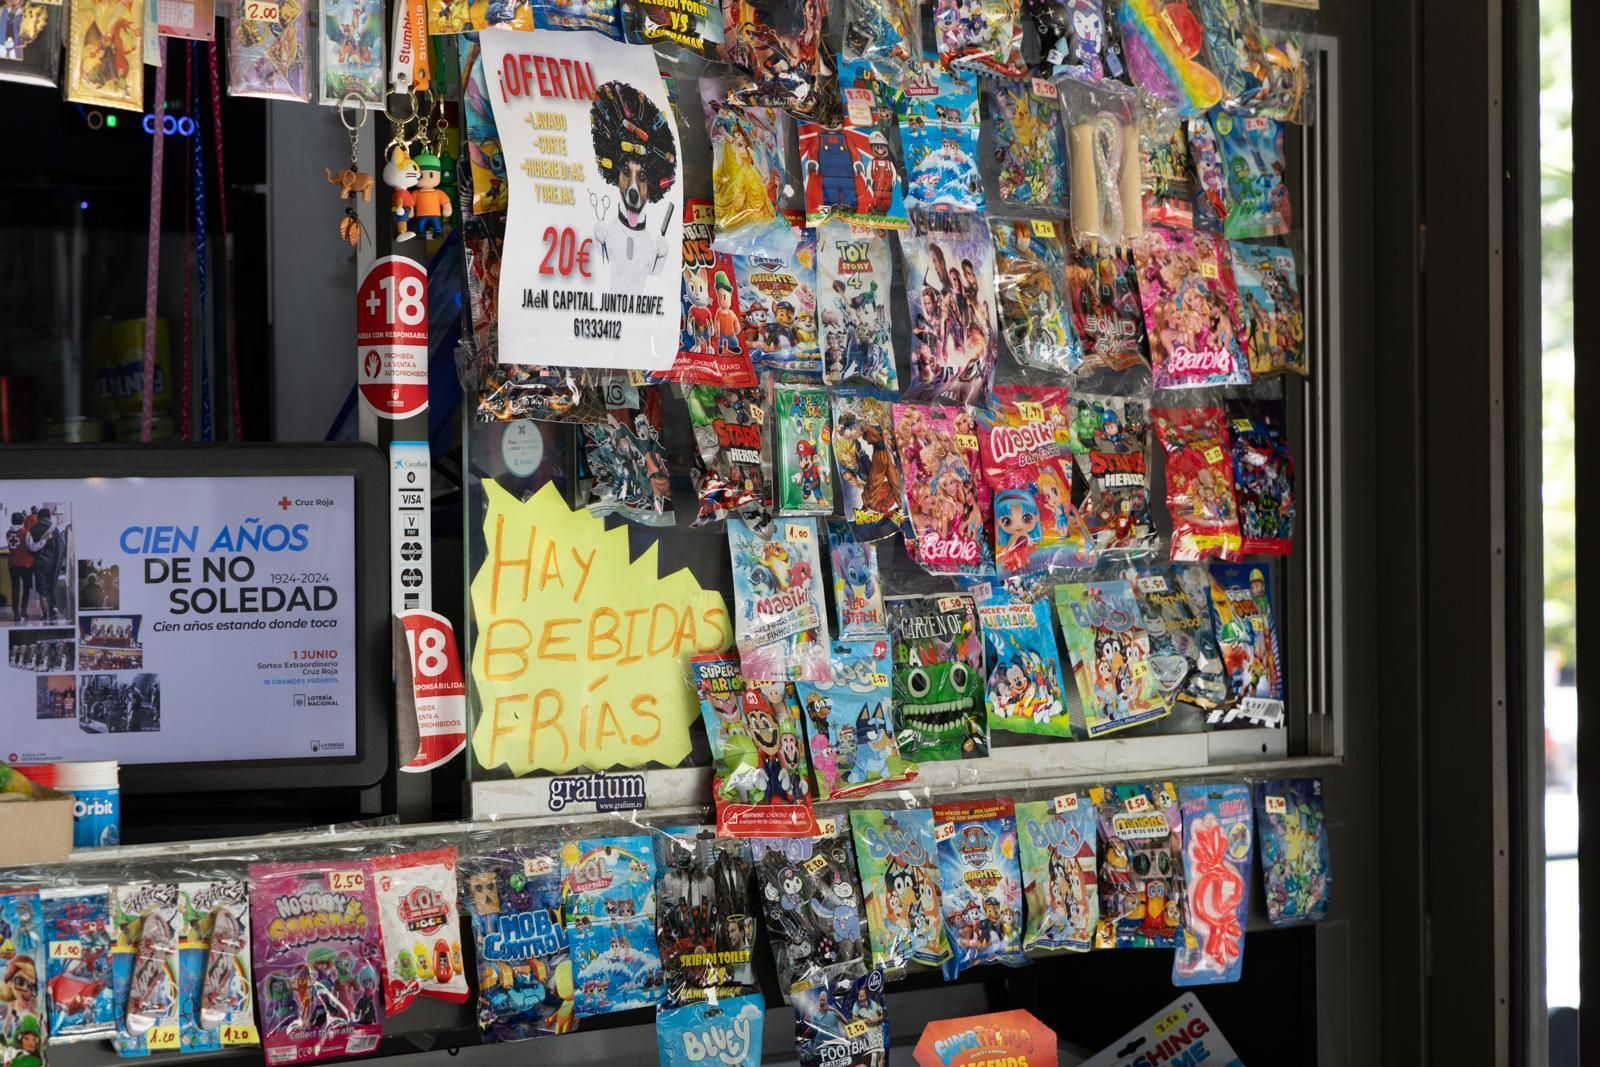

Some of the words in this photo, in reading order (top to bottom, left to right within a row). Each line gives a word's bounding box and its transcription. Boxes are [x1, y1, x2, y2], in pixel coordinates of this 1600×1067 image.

[249, 4, 278, 19] 2.00
[670, 11, 688, 32] VS
[399, 11, 412, 64] Stumbl
[538, 226, 593, 278] 20€
[836, 241, 869, 262] TOY
[842, 262, 869, 270] STORY
[847, 272, 862, 289] 4
[366, 276, 426, 326] +18
[553, 290, 598, 313] CAPITAL.
[599, 293, 627, 314] JUNTO
[628, 294, 635, 313] A
[636, 295, 665, 316] RENFE.
[573, 317, 622, 340] 613334112
[1172, 346, 1235, 371] Barbie
[295, 499, 314, 507] Cruz
[315, 498, 334, 507] Roja
[402, 494, 422, 504] VISA
[119, 525, 199, 554] CIEN
[209, 517, 309, 553] AÑOS
[920, 532, 977, 561] Barbie
[144, 557, 191, 584] DE
[203, 555, 255, 583] NO
[490, 514, 597, 616] HAY
[270, 573, 330, 584] 1924-2024
[170, 585, 338, 615] SOLEDAD
[757, 588, 809, 615] Magiki
[941, 600, 962, 610] 2.50
[980, 606, 1005, 614] MICKEY
[1008, 604, 1032, 613] MOUSE
[153, 621, 181, 633] Cien
[188, 620, 214, 632] años
[216, 620, 265, 632] estando
[269, 619, 309, 630] donde
[310, 618, 338, 629] toca
[950, 614, 962, 634] OF
[483, 601, 727, 682] BEBIDAS
[257, 662, 283, 670] Sorteo
[284, 660, 339, 669] Extraordinario
[301, 649, 338, 660] JUNIO
[321, 668, 339, 676] Roja
[699, 664, 735, 678] SUPER
[699, 676, 743, 692] MARIO
[489, 674, 661, 768] FRÍAS
[73, 800, 113, 817] Orbit
[953, 830, 996, 852] PAW
[333, 873, 363, 889] 2.50
[275, 892, 348, 918] NOBODY
[500, 910, 551, 943] MOB
[484, 924, 570, 961] CONTROL
[679, 953, 716, 968] SKIBIDI
[717, 950, 750, 965] TOILET
